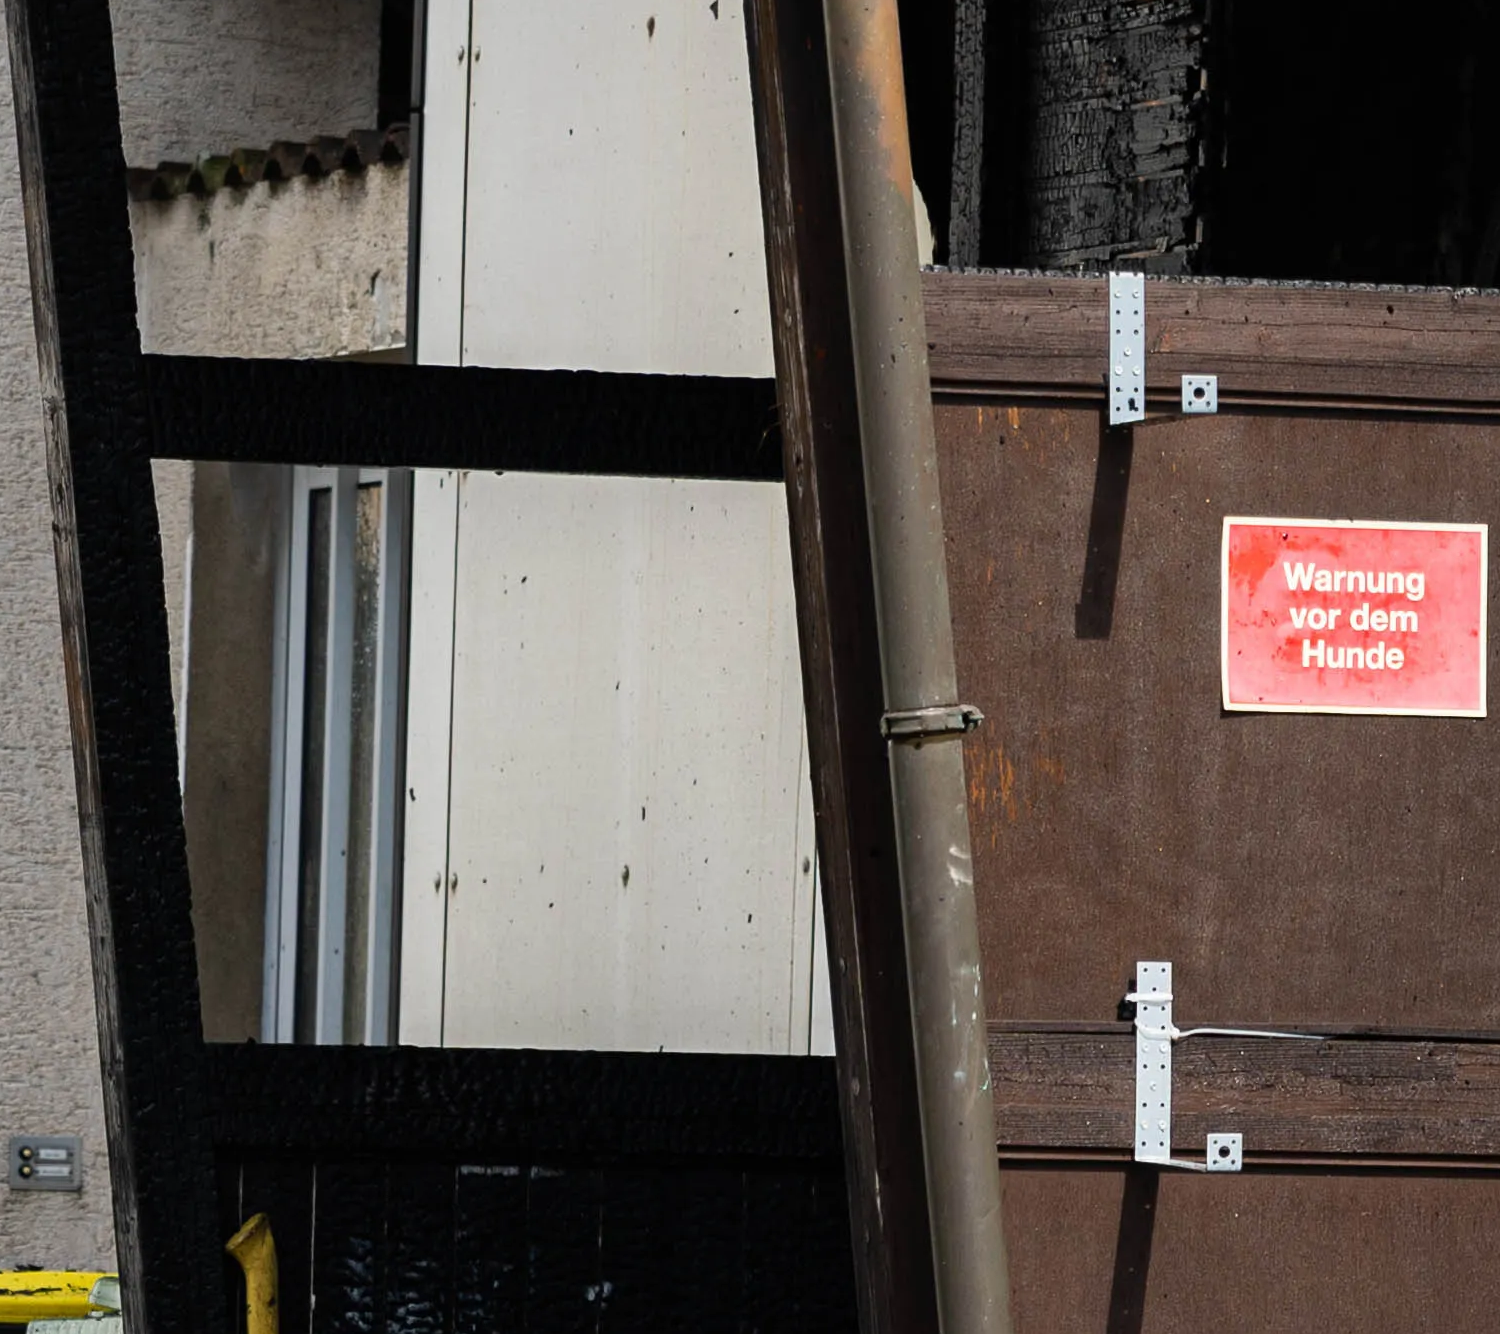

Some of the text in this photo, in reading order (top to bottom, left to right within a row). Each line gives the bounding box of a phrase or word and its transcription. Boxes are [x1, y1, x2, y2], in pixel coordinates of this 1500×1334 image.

[1283, 561, 1426, 601] Warnung
[1288, 602, 1419, 632] vor dem
[1301, 638, 1405, 670] Hunde
